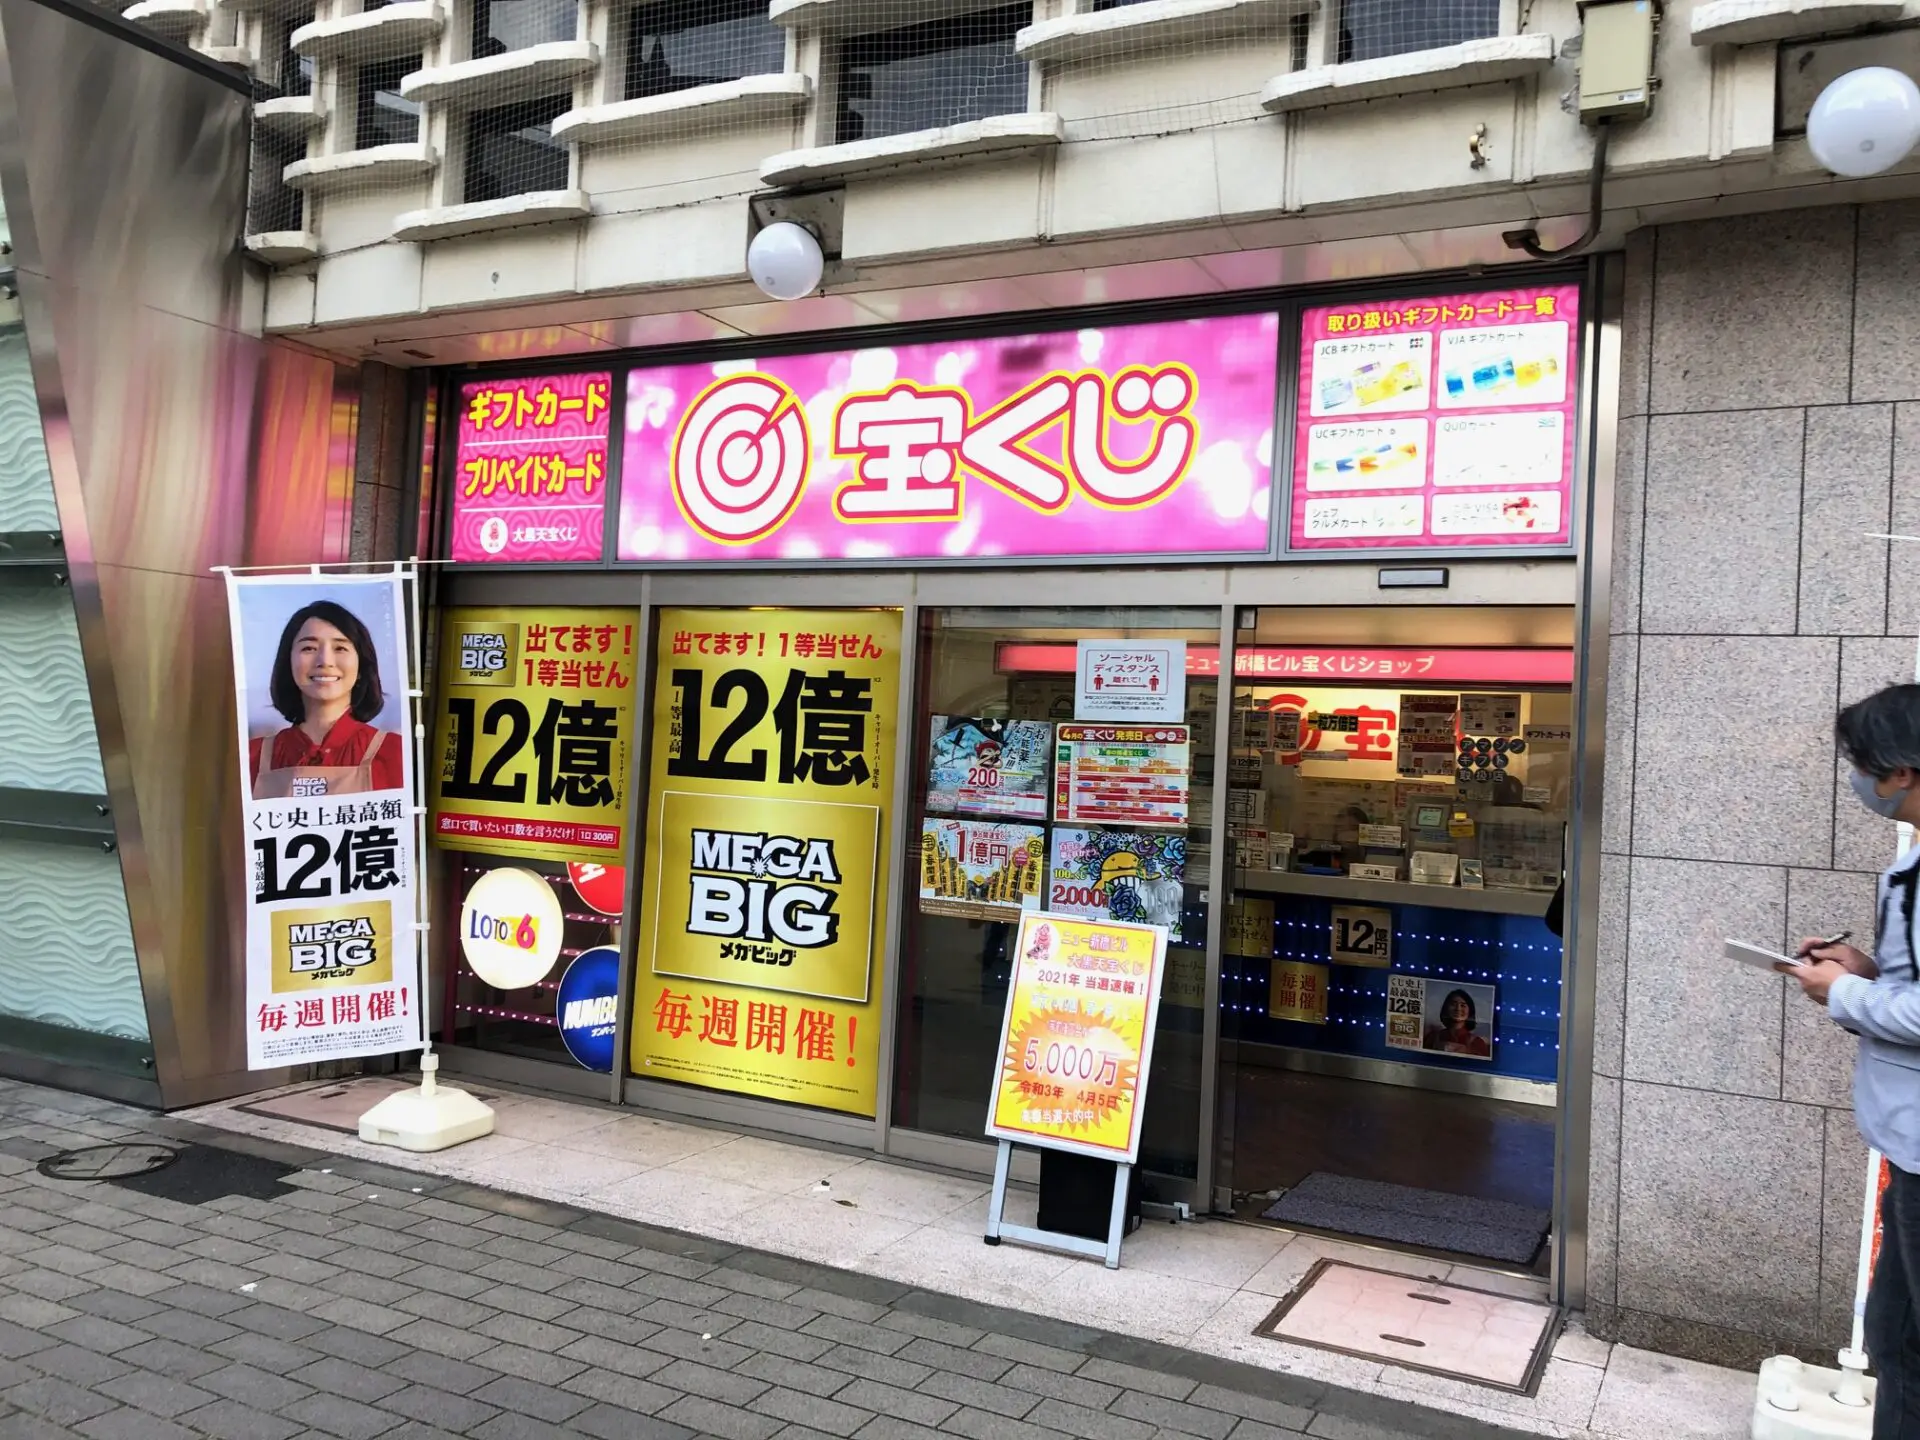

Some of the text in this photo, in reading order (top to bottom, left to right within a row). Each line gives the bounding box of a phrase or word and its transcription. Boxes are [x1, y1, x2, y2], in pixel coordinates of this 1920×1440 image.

[1326, 296, 1557, 333] 取り扱いギフトカード一覧
[1321, 345, 1338, 356] JCB
[467, 382, 608, 430] ギフトカード
[830, 360, 1200, 525] 宝くじ
[463, 451, 604, 498] プリペイドカード
[461, 633, 508, 650] MEGA
[778, 632, 883, 659] 1等当せん
[460, 647, 508, 671] BIG
[1093, 664, 1161, 673] ディスタンス
[1099, 654, 1156, 662] ソーシャル
[524, 659, 630, 689] 1等当せん
[667, 668, 873, 787] 12億
[1062, 728, 1144, 742] 4月の宝くじ発売日
[1333, 704, 1397, 761] 宝
[441, 697, 618, 808] 12億
[292, 777, 327, 787] MEGA
[292, 785, 327, 797] BIG
[967, 767, 998, 787] 200
[252, 799, 404, 832] くじ史上最高額
[690, 828, 843, 884] MEGA
[956, 830, 1010, 868] 1億円
[254, 825, 401, 904] 12億
[686, 873, 842, 949] BIG
[289, 917, 376, 944] MEGA
[515, 913, 536, 949] 6
[289, 937, 377, 973] BIG
[719, 943, 797, 966] メガビッグ
[310, 968, 356, 981] メガビッグ
[1038, 969, 1081, 987] 2021年
[1281, 972, 1316, 992] 毎週
[256, 986, 409, 1033] 毎週開催！
[1389, 997, 1422, 1015] 12億
[652, 987, 858, 1068] 毎週開催！
[1024, 1038, 1118, 1087] 5,000万
[1020, 1080, 1119, 1109] 令和3年 4月5日
